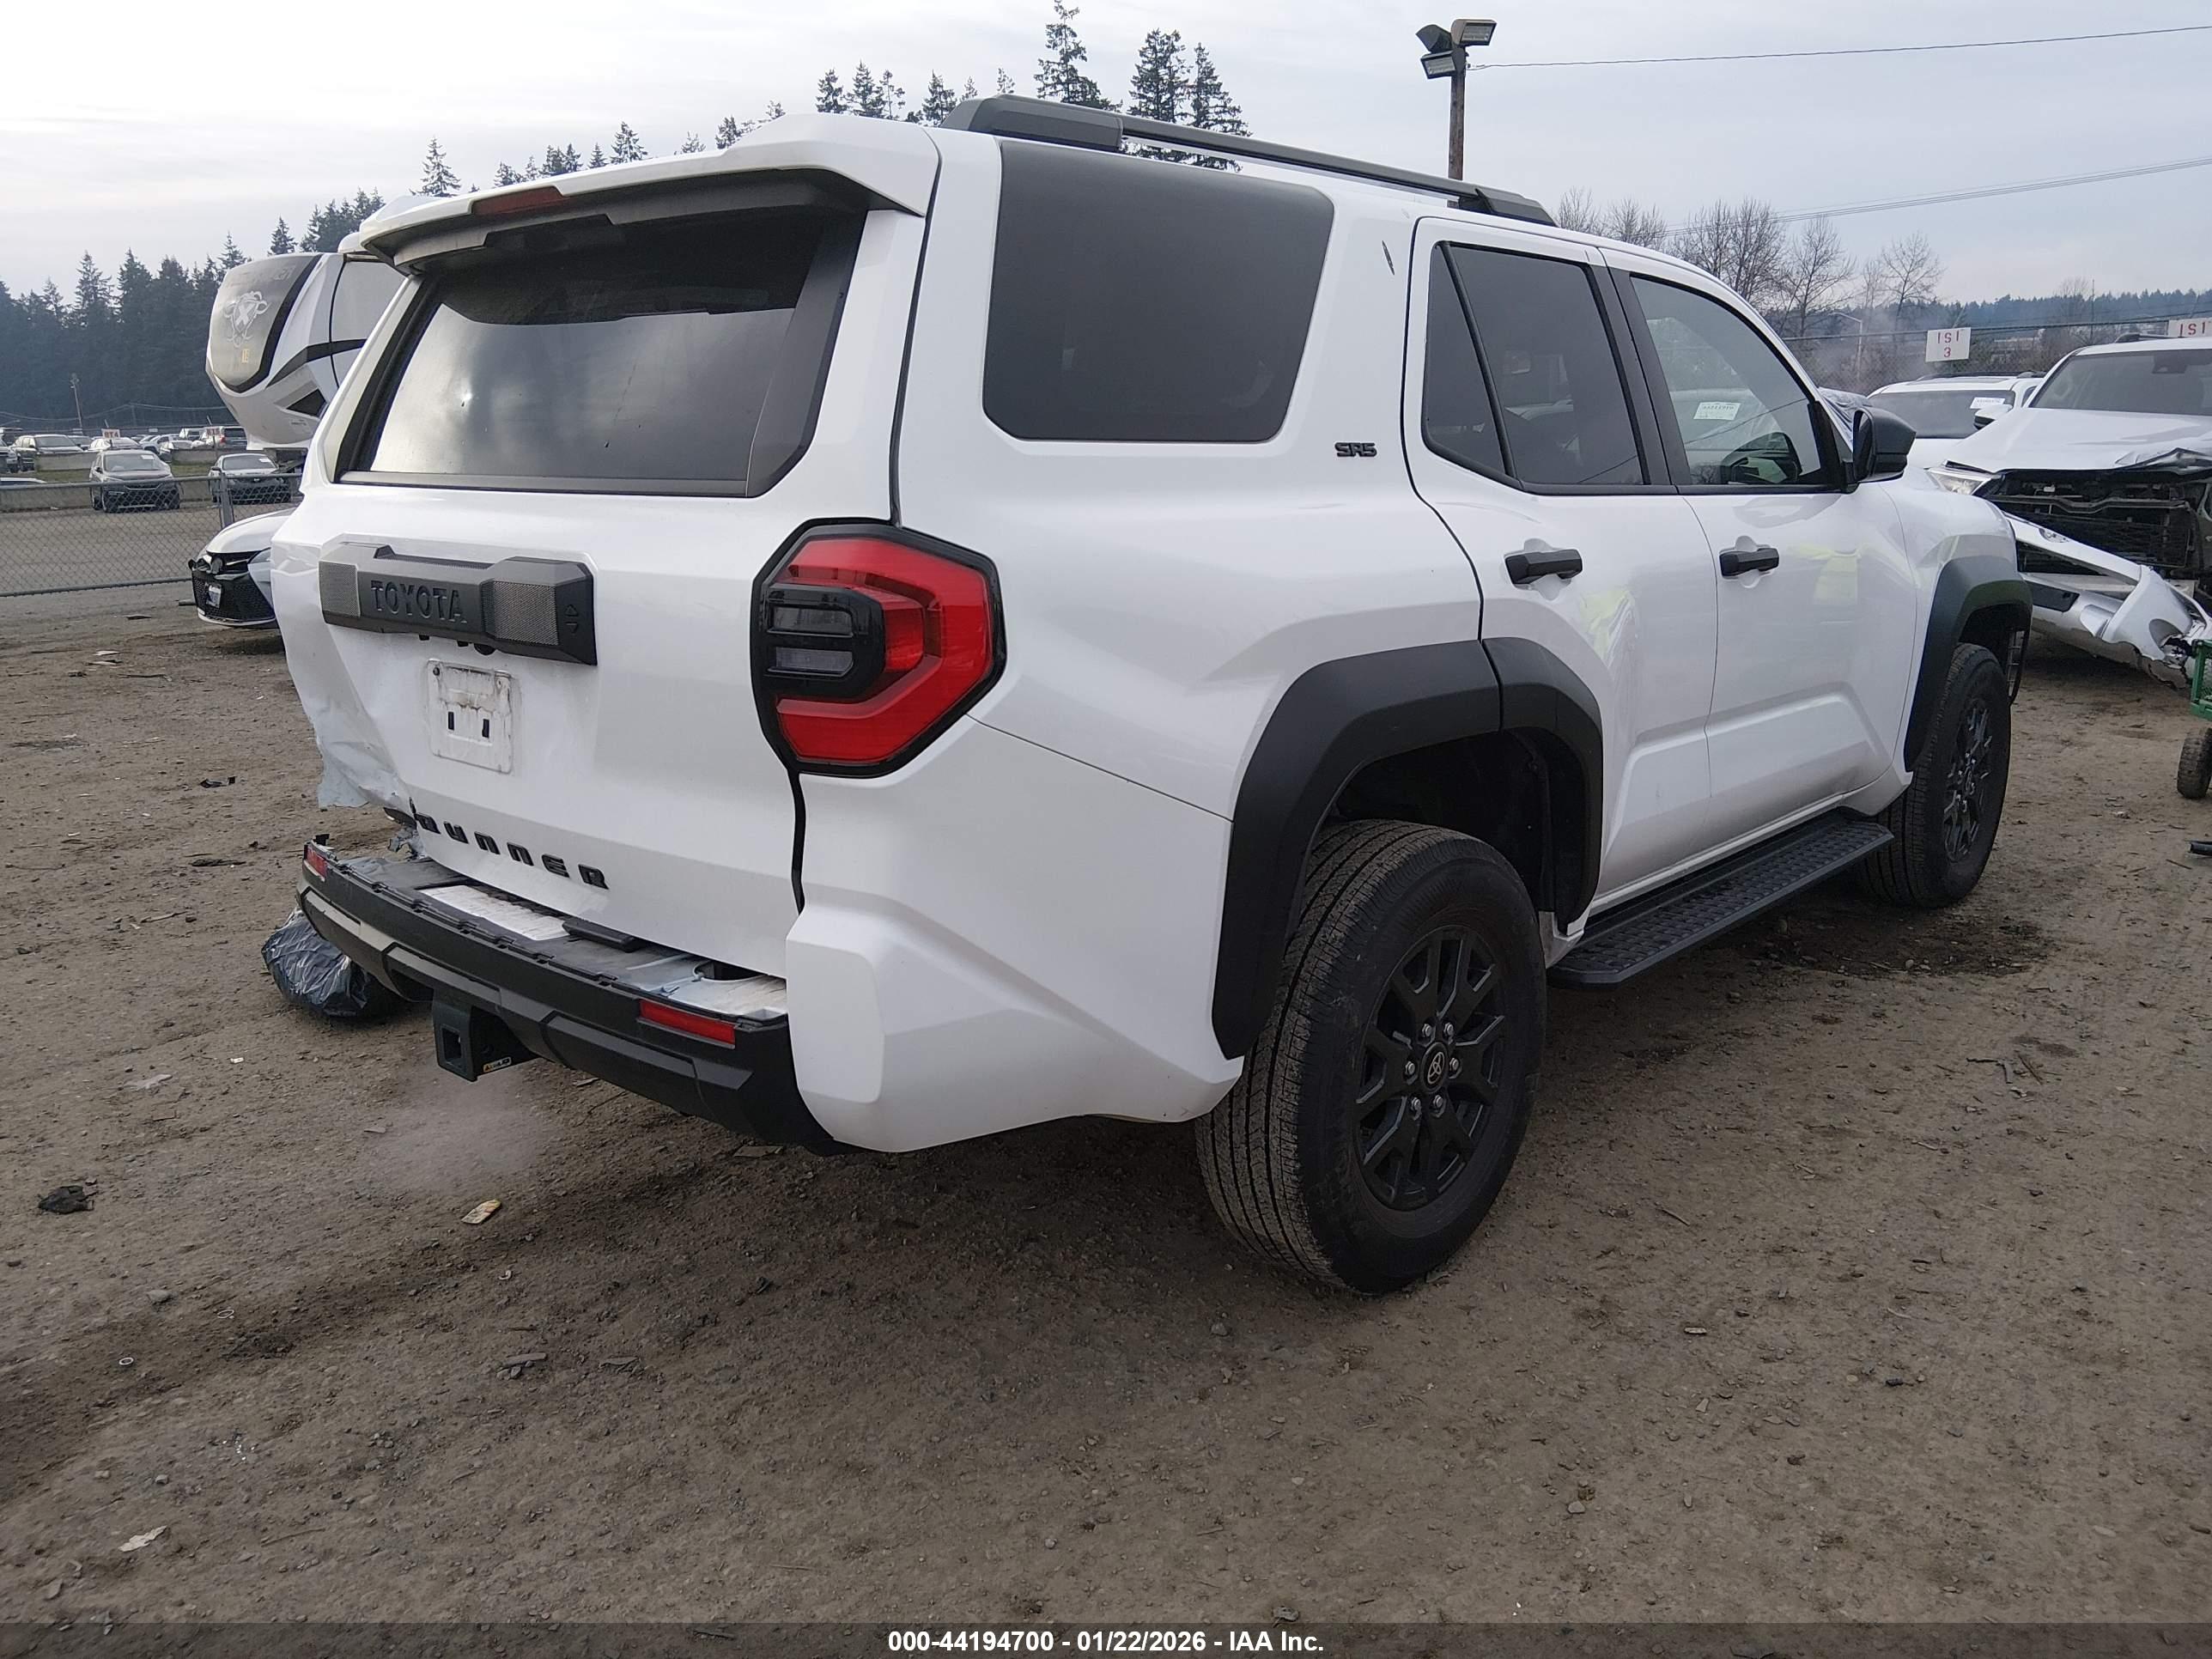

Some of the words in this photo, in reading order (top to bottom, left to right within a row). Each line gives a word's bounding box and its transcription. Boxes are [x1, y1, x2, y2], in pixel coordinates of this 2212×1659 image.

[1943, 347, 1952, 358] 3
[1334, 441, 1377, 457] SR5
[370, 580, 467, 623] TOYOTA
[409, 797, 609, 890] RUNNER
